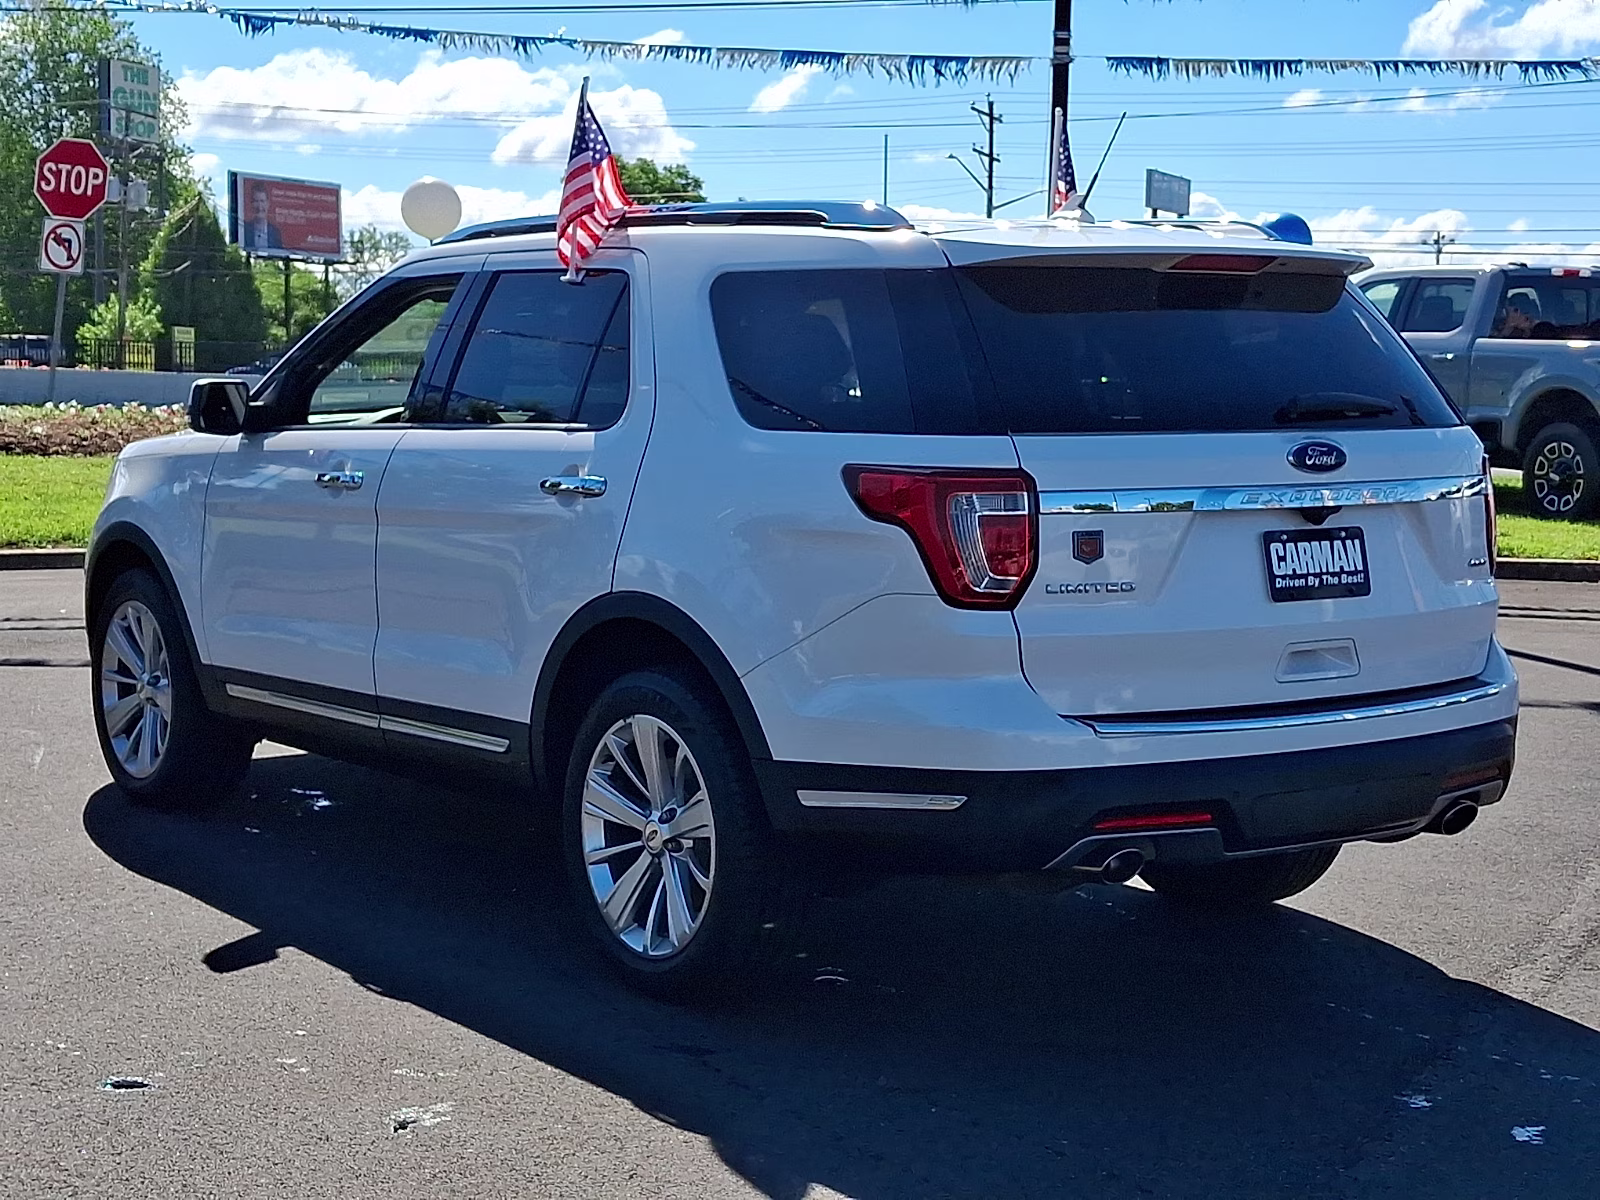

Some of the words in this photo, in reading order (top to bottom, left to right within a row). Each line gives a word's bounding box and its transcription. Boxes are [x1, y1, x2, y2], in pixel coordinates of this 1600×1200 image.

[121, 65, 149, 85] THE
[112, 86, 158, 114] GUN
[115, 116, 156, 137] SOP
[40, 162, 104, 196] STOP
[1305, 446, 1337, 465] Ford
[1240, 486, 1401, 506] EXPLORER
[1270, 539, 1364, 575] CARMAN
[1045, 582, 1136, 594] LIMITED
[1275, 577, 1306, 588] Driven
[1307, 576, 1320, 588] By
[1322, 574, 1339, 584] The
[1341, 573, 1364, 583] Best!
